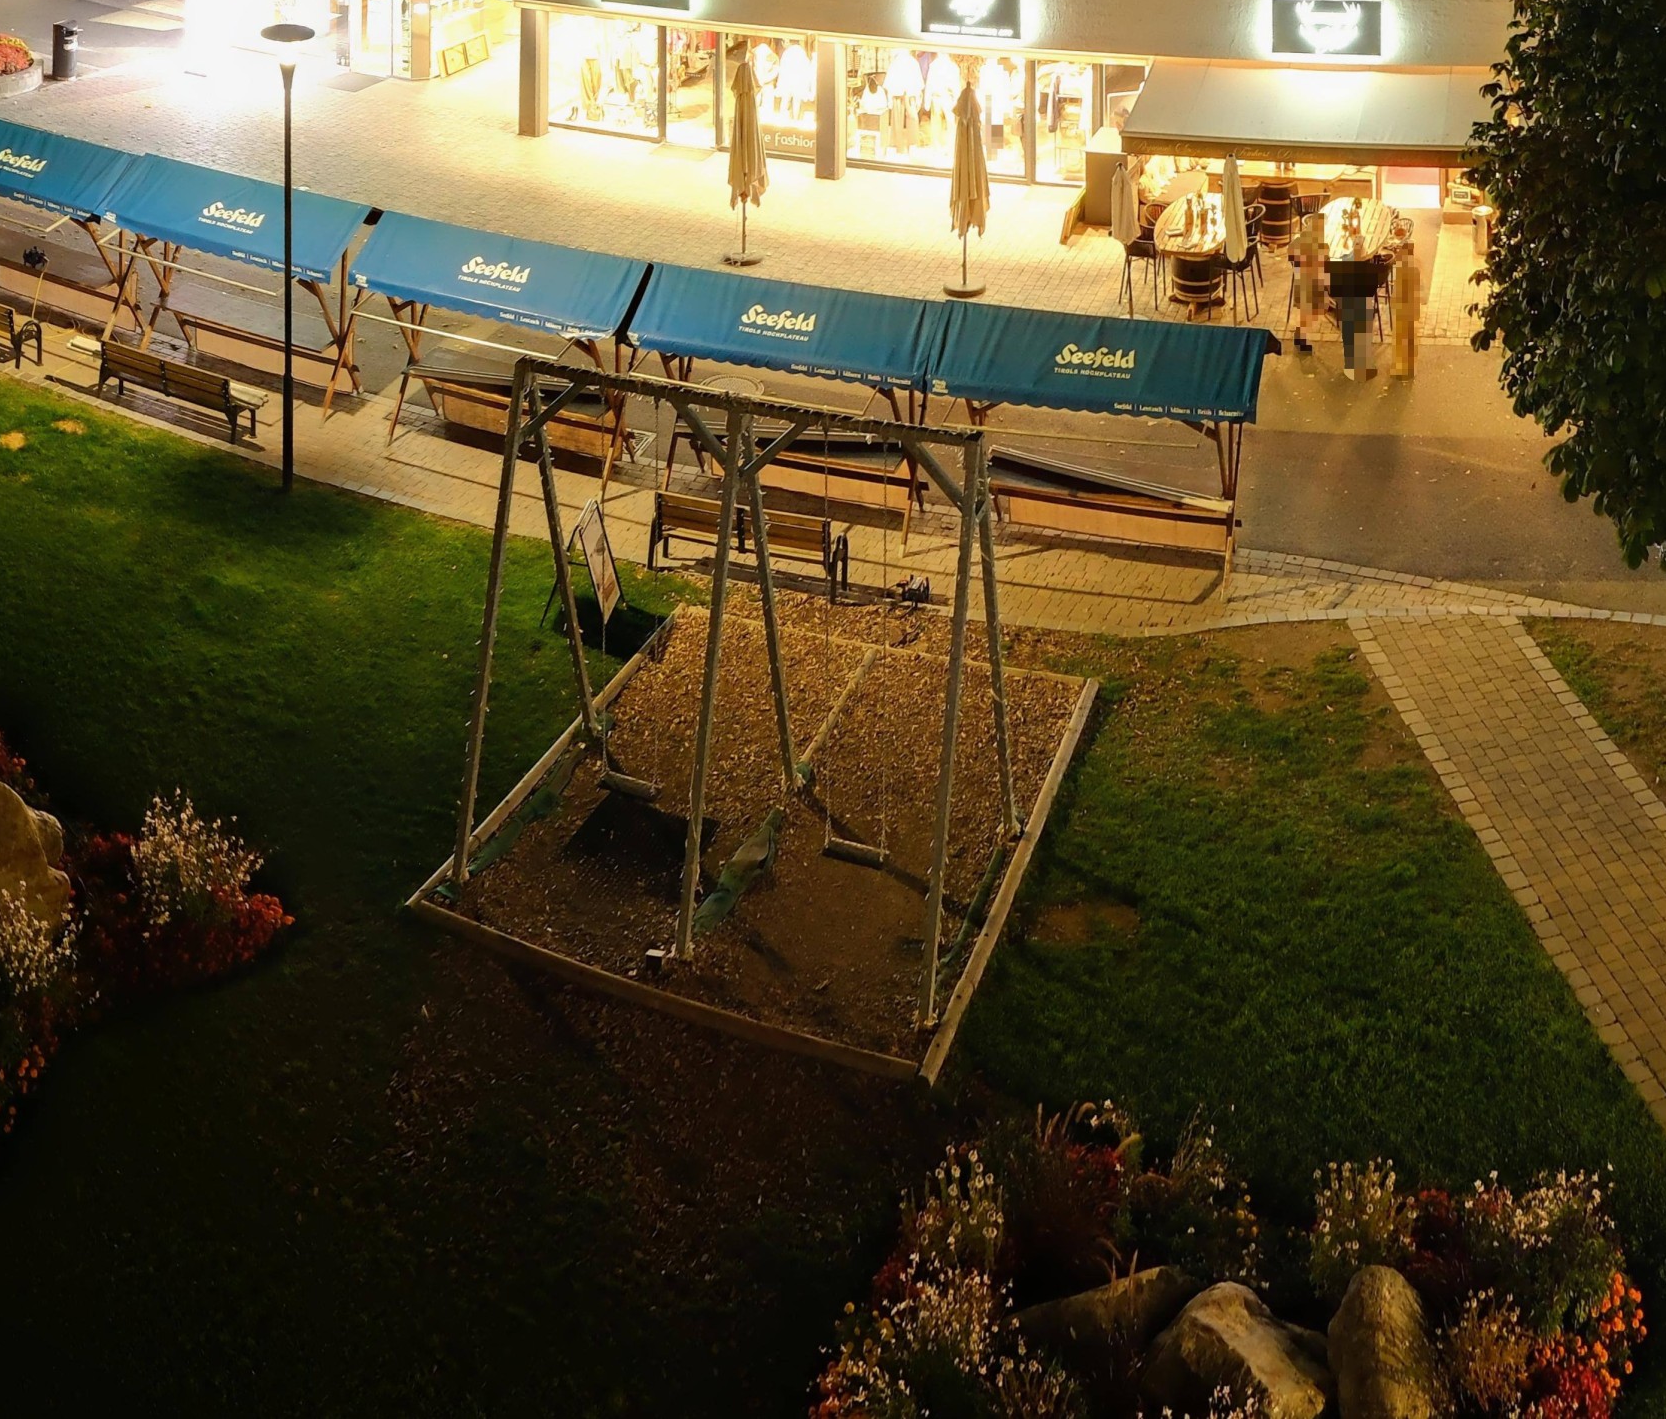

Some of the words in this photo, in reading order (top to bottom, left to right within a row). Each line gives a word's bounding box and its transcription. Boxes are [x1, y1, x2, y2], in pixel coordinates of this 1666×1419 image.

[203, 201, 265, 227] Seefeld
[461, 256, 532, 284] Seefeld
[741, 304, 817, 332] Seefeld
[1055, 343, 1136, 370] Seefeld
[1054, 367, 1078, 376] TIROLS
[1080, 369, 1132, 380] HOCHPLATEAU
